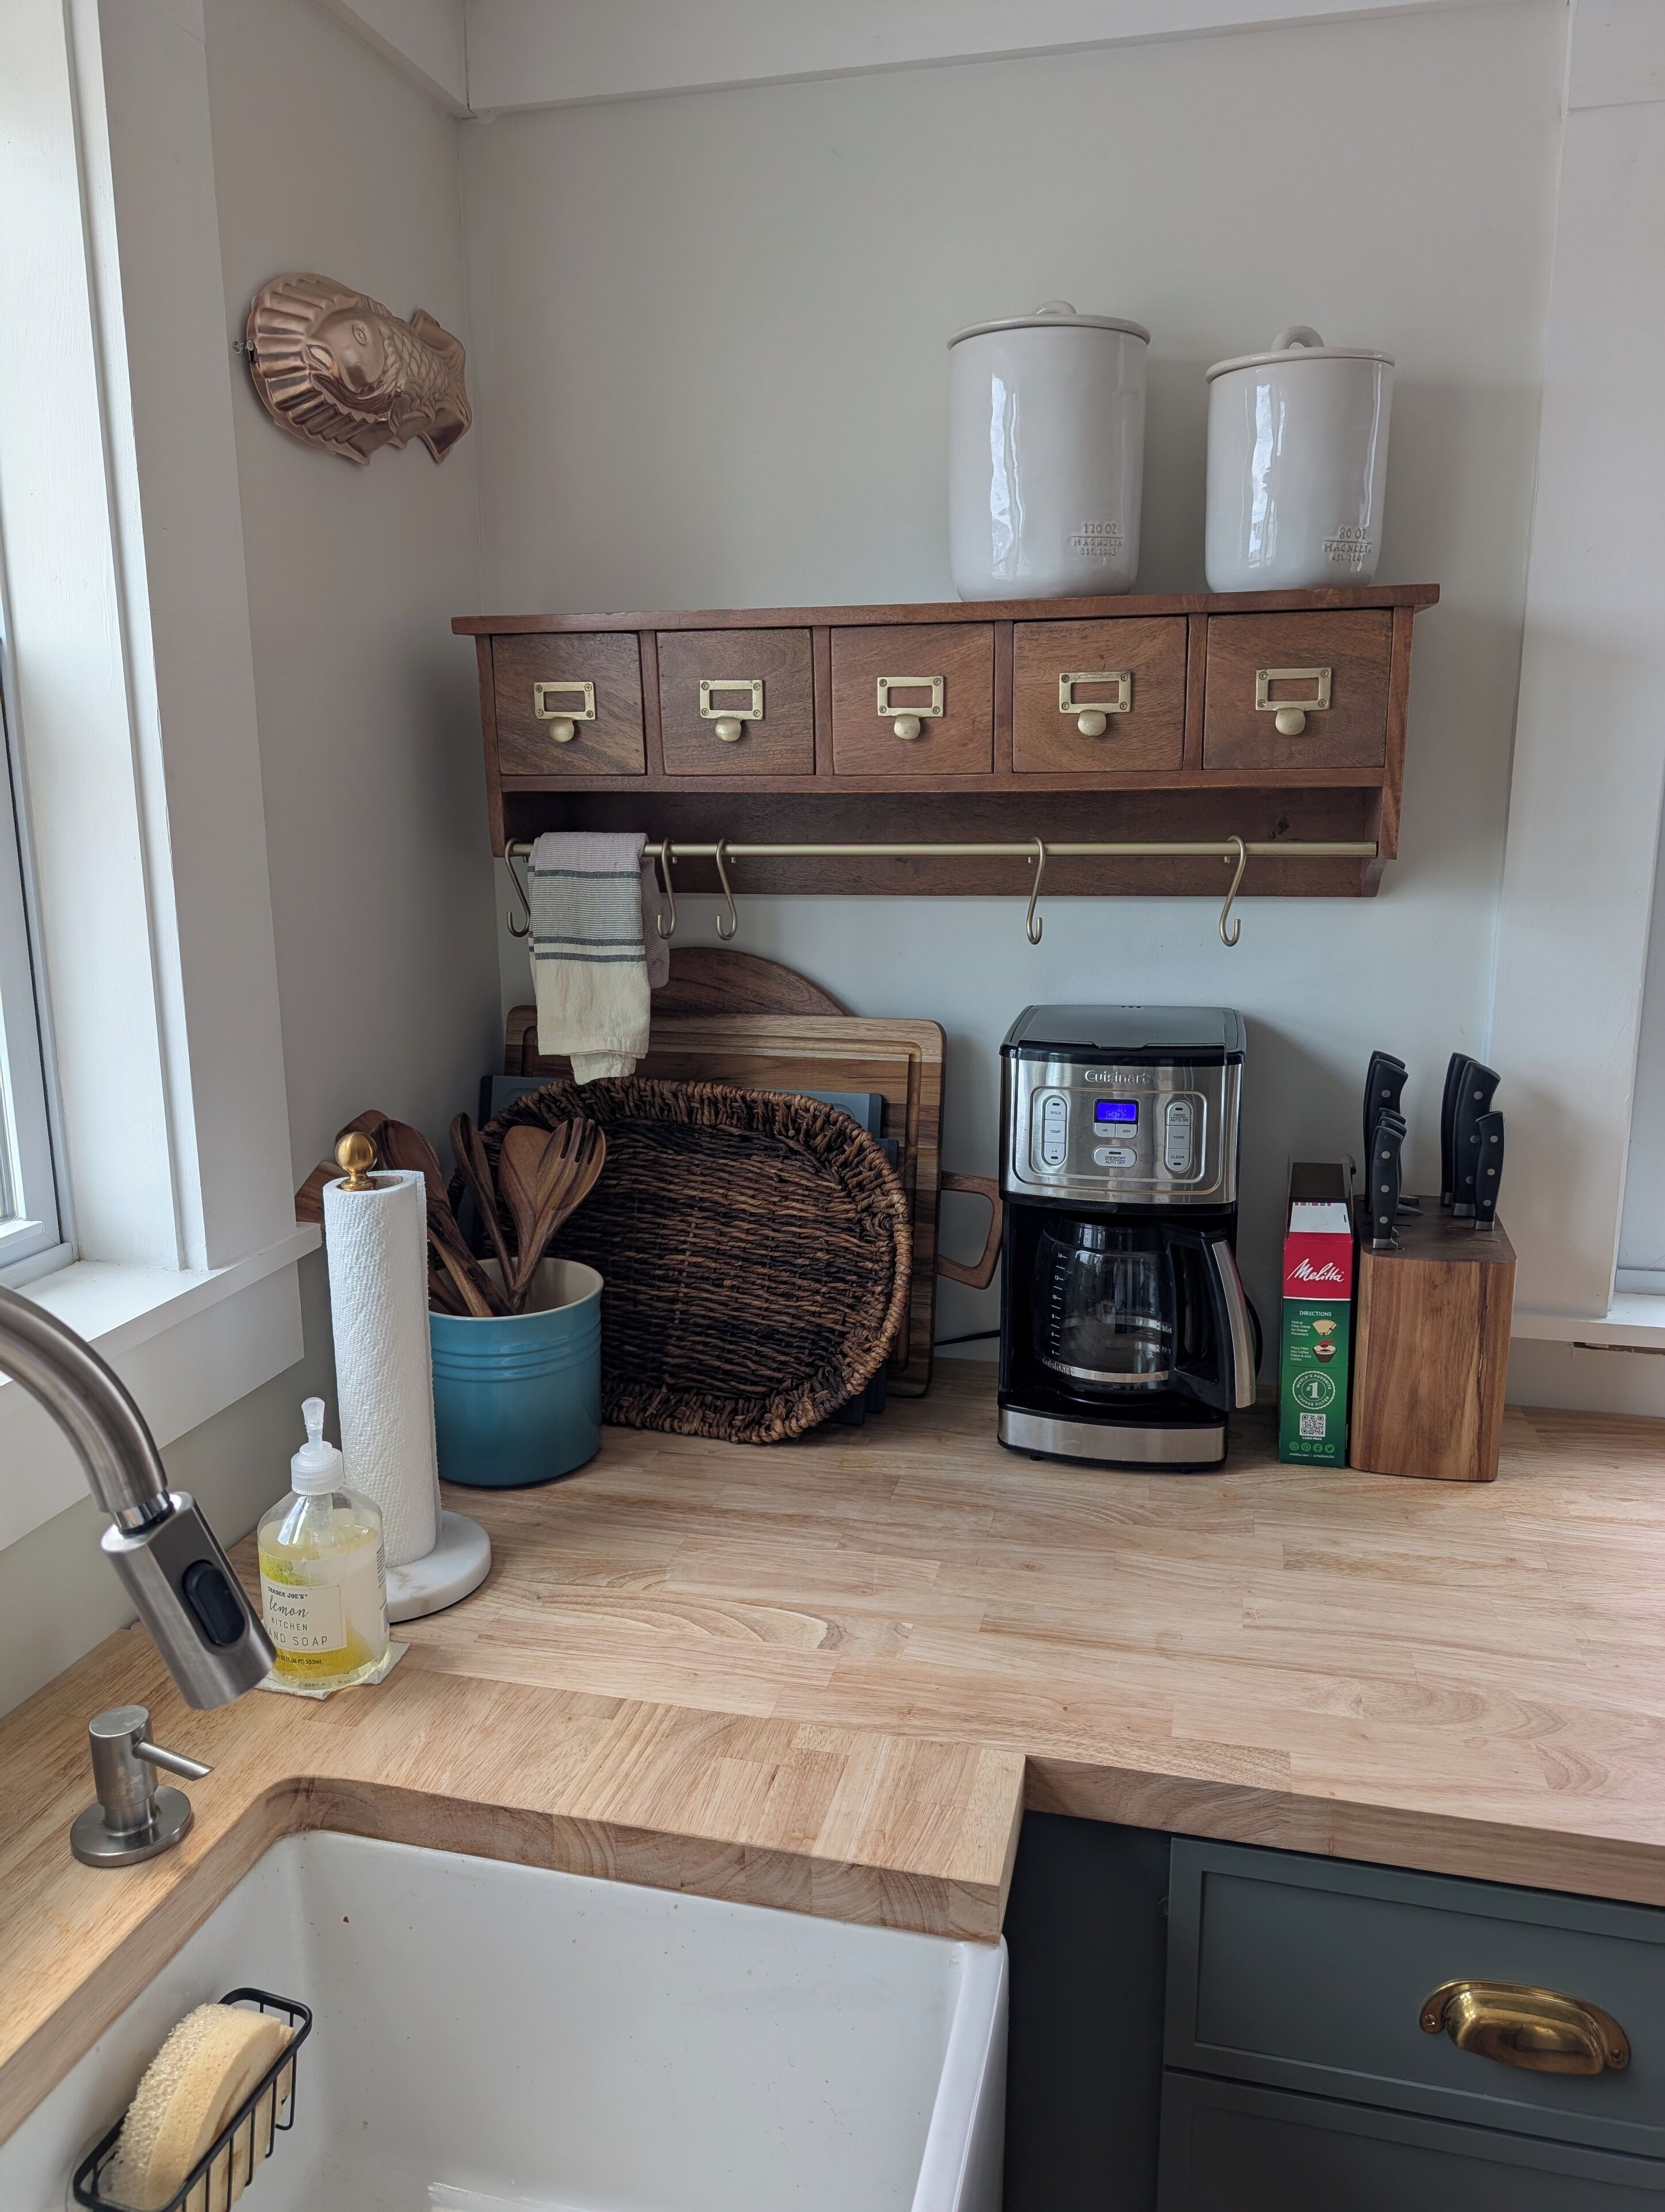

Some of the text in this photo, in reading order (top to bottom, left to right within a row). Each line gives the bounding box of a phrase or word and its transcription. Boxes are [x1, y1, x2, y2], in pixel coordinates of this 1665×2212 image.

[1083, 523, 1117, 535] 120 OZ
[1340, 527, 1366, 539] 80 OZ
[1074, 539, 1122, 547] MAGNOLIA
[1325, 544, 1372, 553] MAGNOLIA
[1085, 1070, 1151, 1084] Cuisinart
[1287, 1258, 1344, 1282] Melitta
[1296, 1374, 1332, 1389] WORLD'S FAVORITE
[1306, 1382, 1319, 1398] #1
[1298, 1395, 1330, 1406] COFFEE FILTER
[268, 1586, 286, 1597] TRADER
[270, 1594, 309, 1618] lemon
[271, 1616, 308, 1631] KITCHEN
[293, 1636, 327, 1646] SOAP
